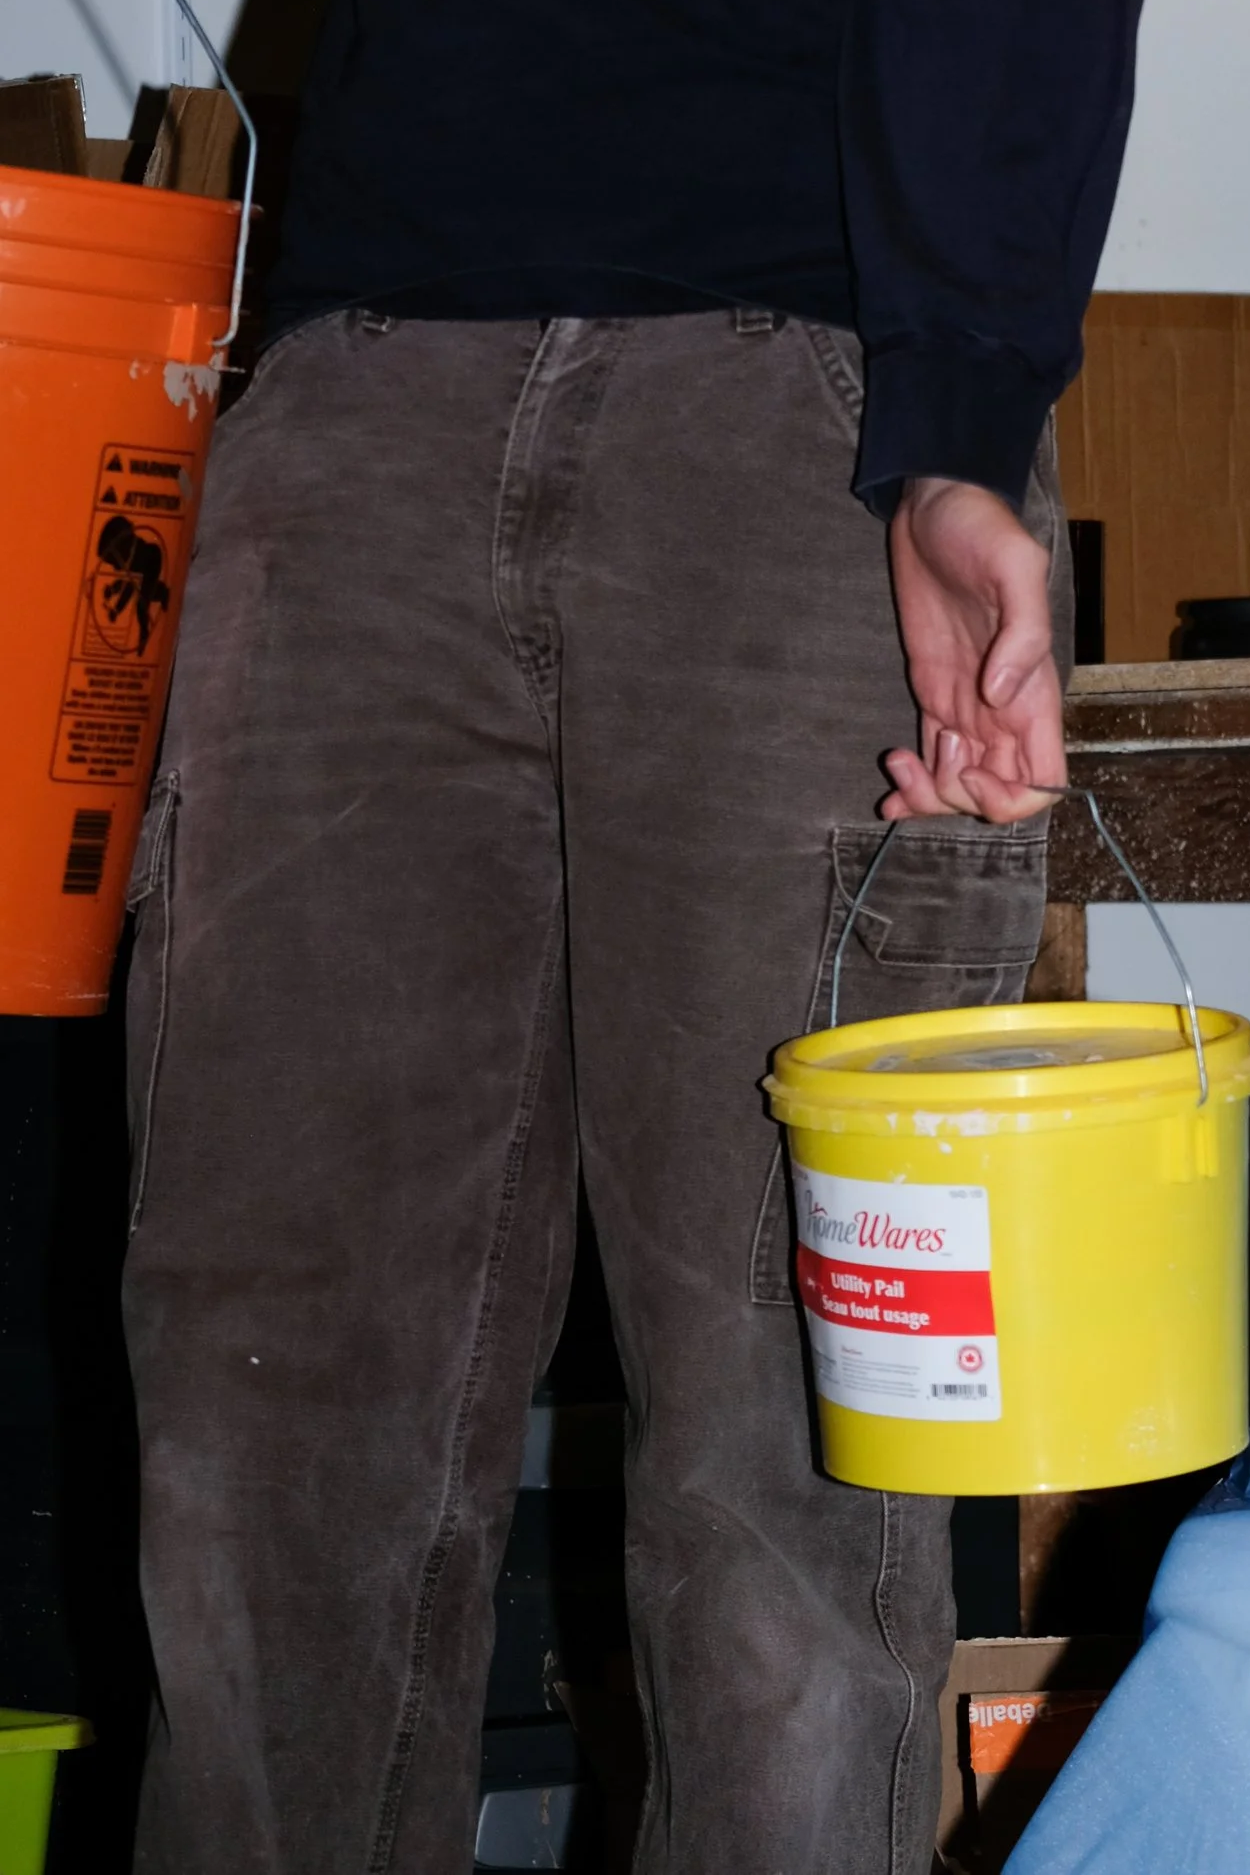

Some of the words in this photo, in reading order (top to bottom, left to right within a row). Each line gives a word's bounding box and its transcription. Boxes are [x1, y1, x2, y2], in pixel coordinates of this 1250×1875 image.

[830, 1272, 872, 1299] Utility
[874, 1279, 905, 1299] Pail
[821, 1294, 848, 1315] Seau
[849, 1302, 881, 1321] tout
[883, 1306, 931, 1330] usage
